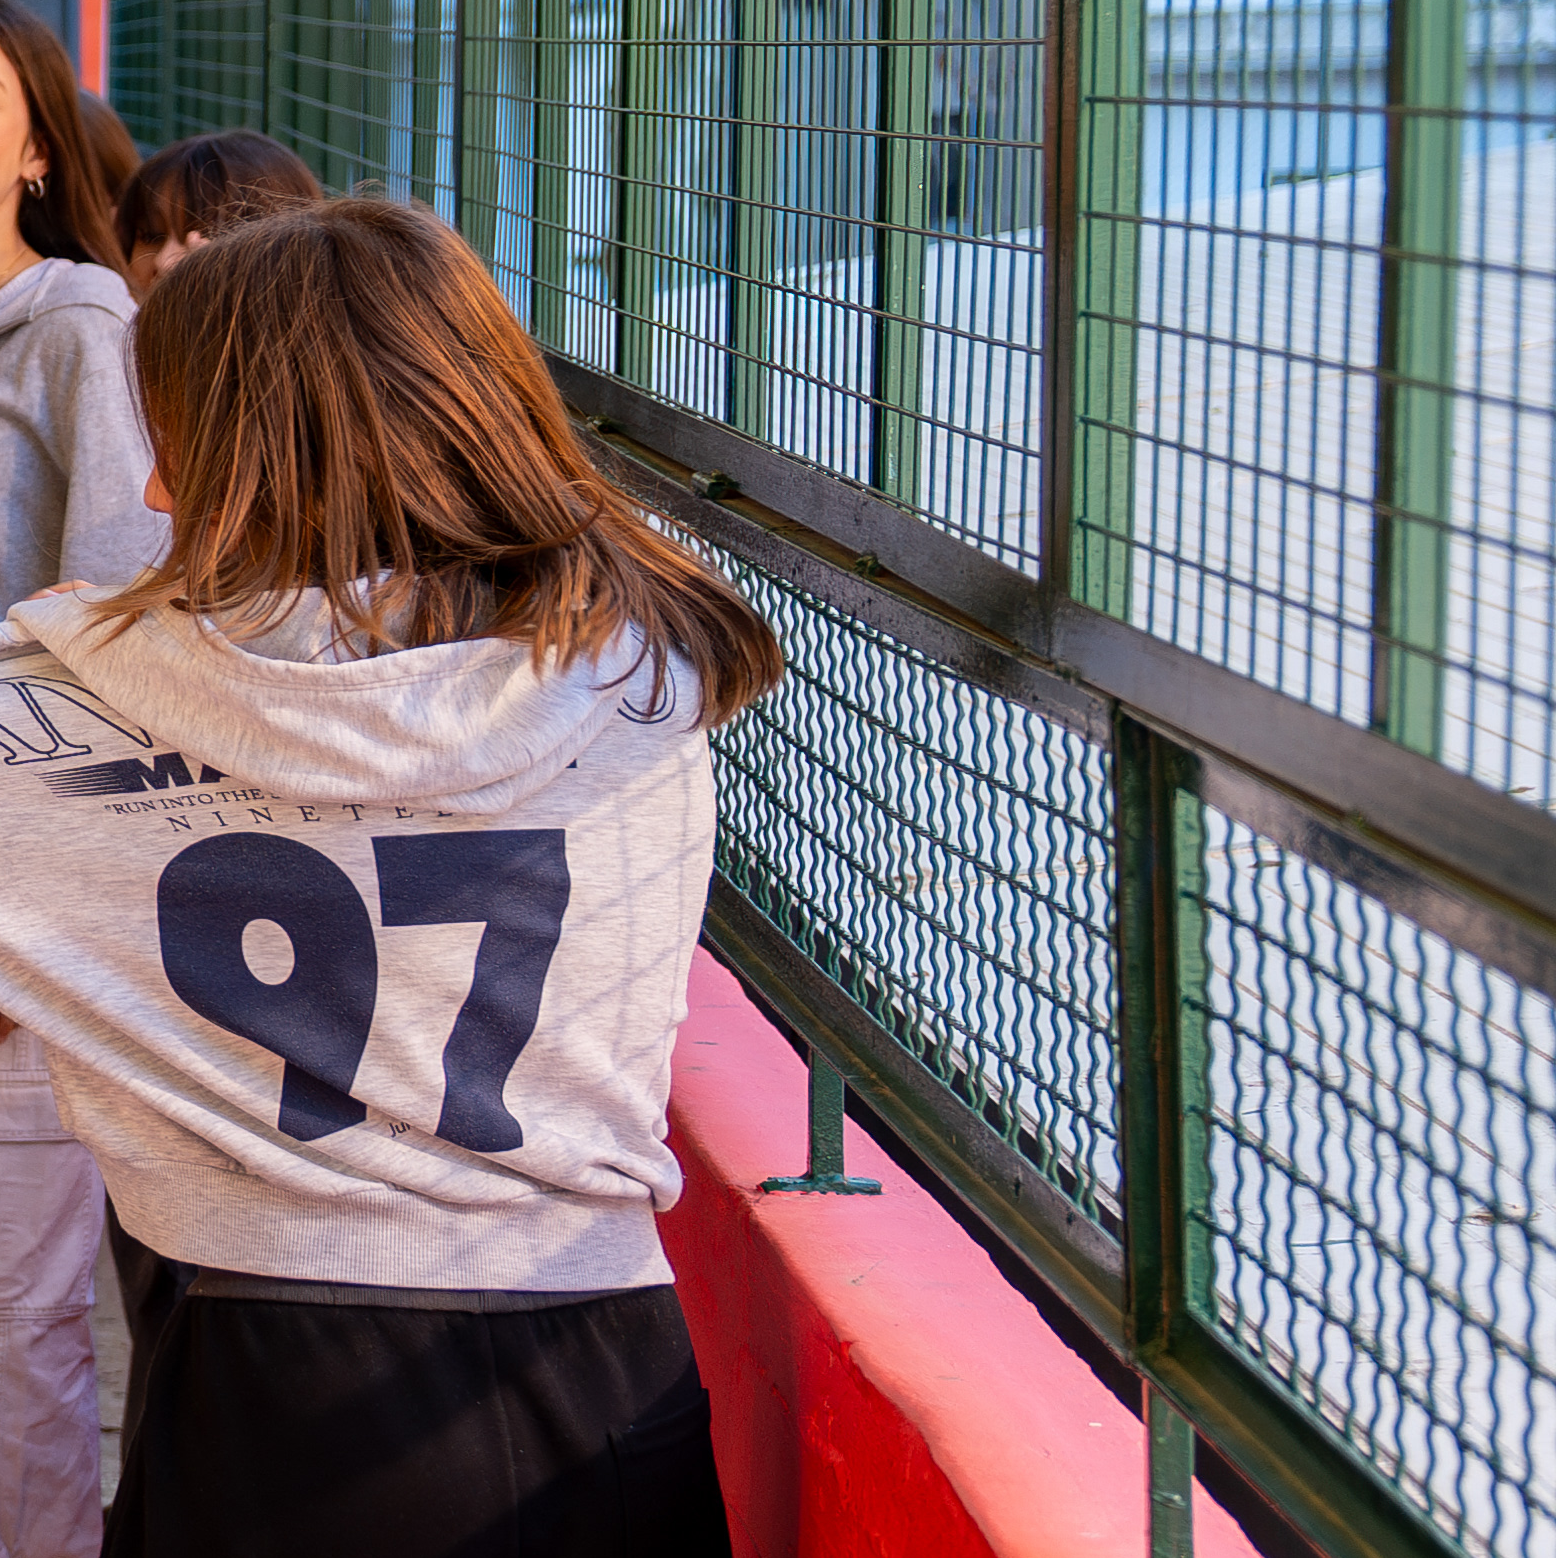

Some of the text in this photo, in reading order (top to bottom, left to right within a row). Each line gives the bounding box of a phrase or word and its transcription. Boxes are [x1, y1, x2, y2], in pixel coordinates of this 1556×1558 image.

[158, 792, 213, 810] INTO
[215, 788, 265, 803] THE
[165, 801, 454, 833] NINETE
[156, 828, 571, 1153] 97
